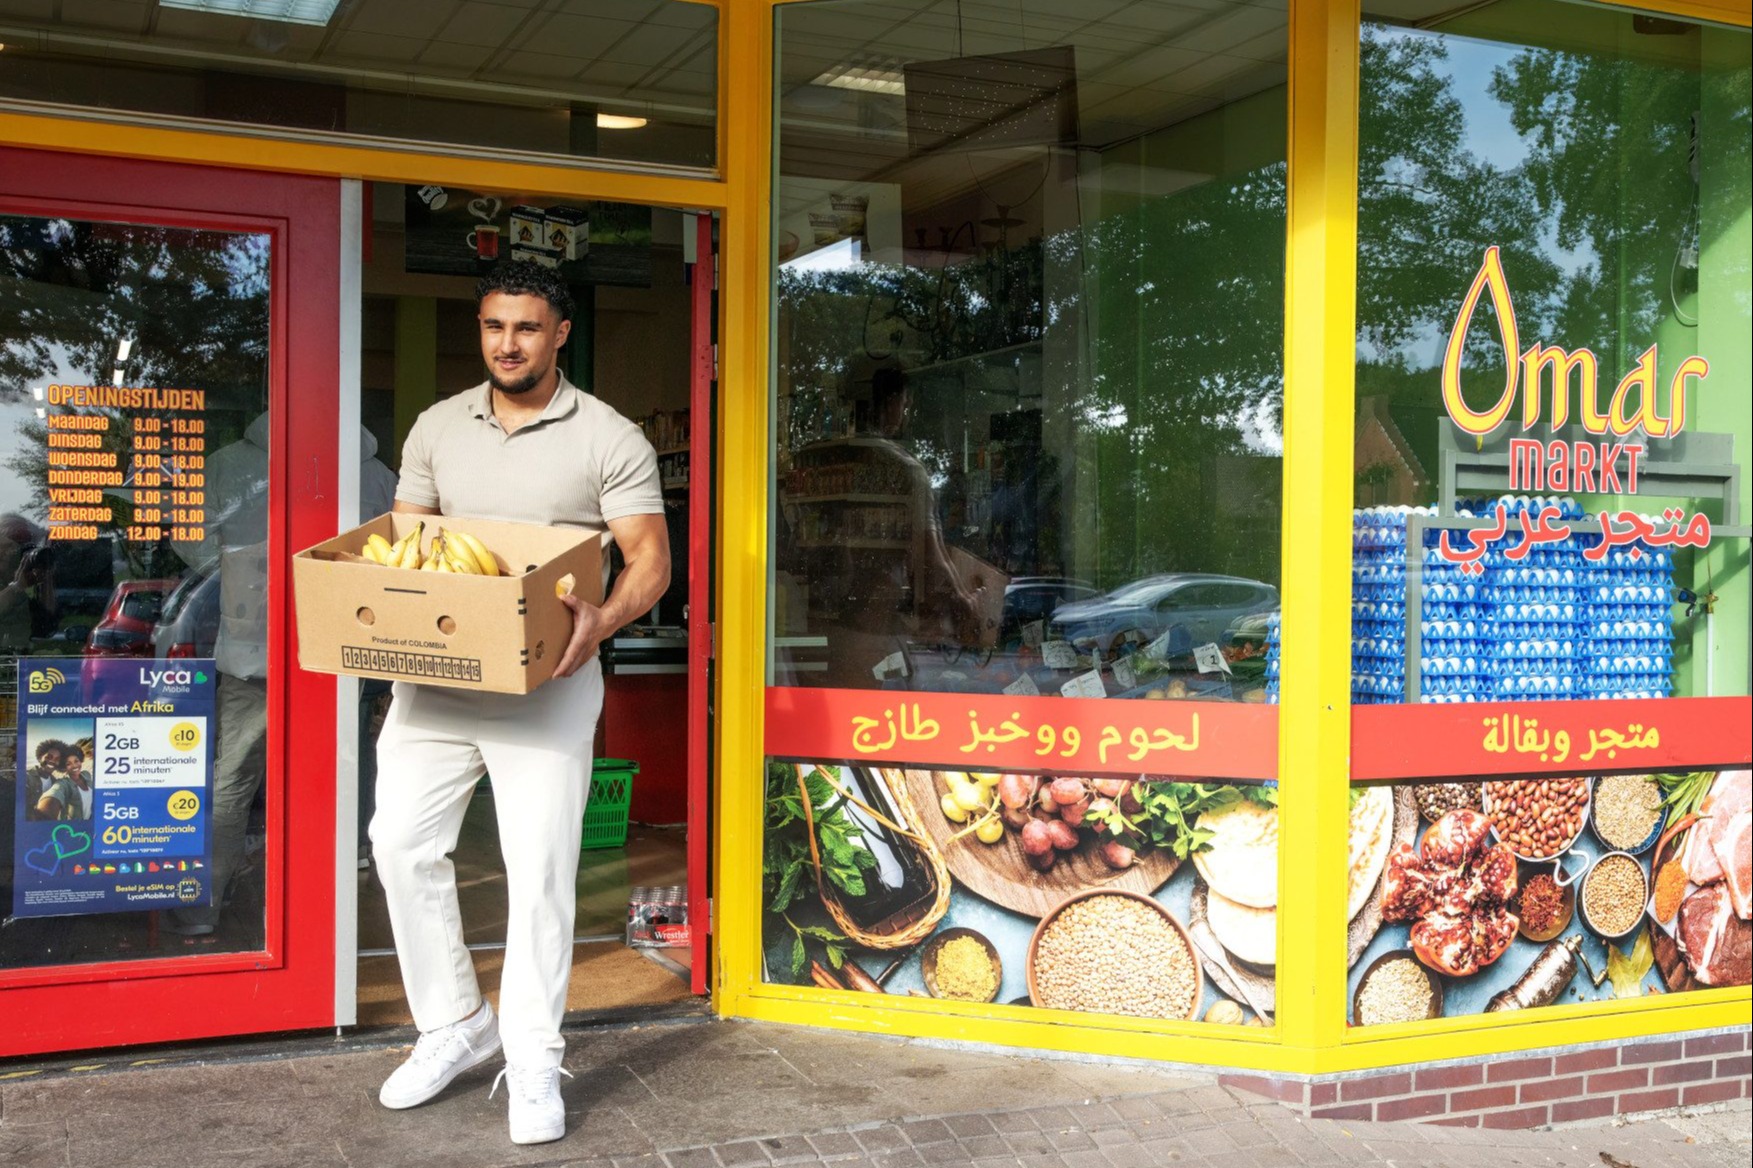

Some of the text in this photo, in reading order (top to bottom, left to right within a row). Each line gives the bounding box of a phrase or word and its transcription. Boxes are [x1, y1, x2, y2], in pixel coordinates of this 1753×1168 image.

[1442, 246, 1709, 438] Omar
[48, 385, 204, 410] OPENINGSTIJDEN
[134, 418, 160, 432] 9.00
[171, 420, 204, 434] 18.00
[134, 436, 160, 450] 9.00
[171, 438, 204, 451] 18.00
[134, 454, 160, 468] 9.00
[171, 456, 204, 469] 18.00
[134, 472, 160, 486] 9.00
[171, 473, 204, 487] 19.00
[134, 490, 160, 504] 9.00
[171, 491, 204, 505] 18.00
[134, 508, 160, 522] 9.00
[171, 509, 204, 523] 18.00
[127, 526, 160, 540] 12.00
[171, 527, 204, 541] 18.00
[1582, 507, 1711, 560] متجر
[372, 636, 399, 646] Product
[408, 639, 447, 650] COLOMBIA
[345, 652, 479, 677] 1 2 3 4 5 6 7 8 9 10 11 12 13 14 15
[31, 677, 50, 691] 5G
[140, 668, 191, 688] Lyca
[27, 700, 174, 714] Blijf connected met Afrika
[851, 703, 940, 753] طازج
[105, 734, 140, 750] 2GB
[1098, 712, 1199, 764] لحوم
[1482, 712, 1660, 762] متجر وبقالة
[104, 756, 197, 774] 25 internationale
[103, 803, 139, 820] 5GB
[173, 798, 196, 810] €20
[102, 825, 196, 845] 60 internationale
[128, 892, 175, 901] LycaMobile.nl
